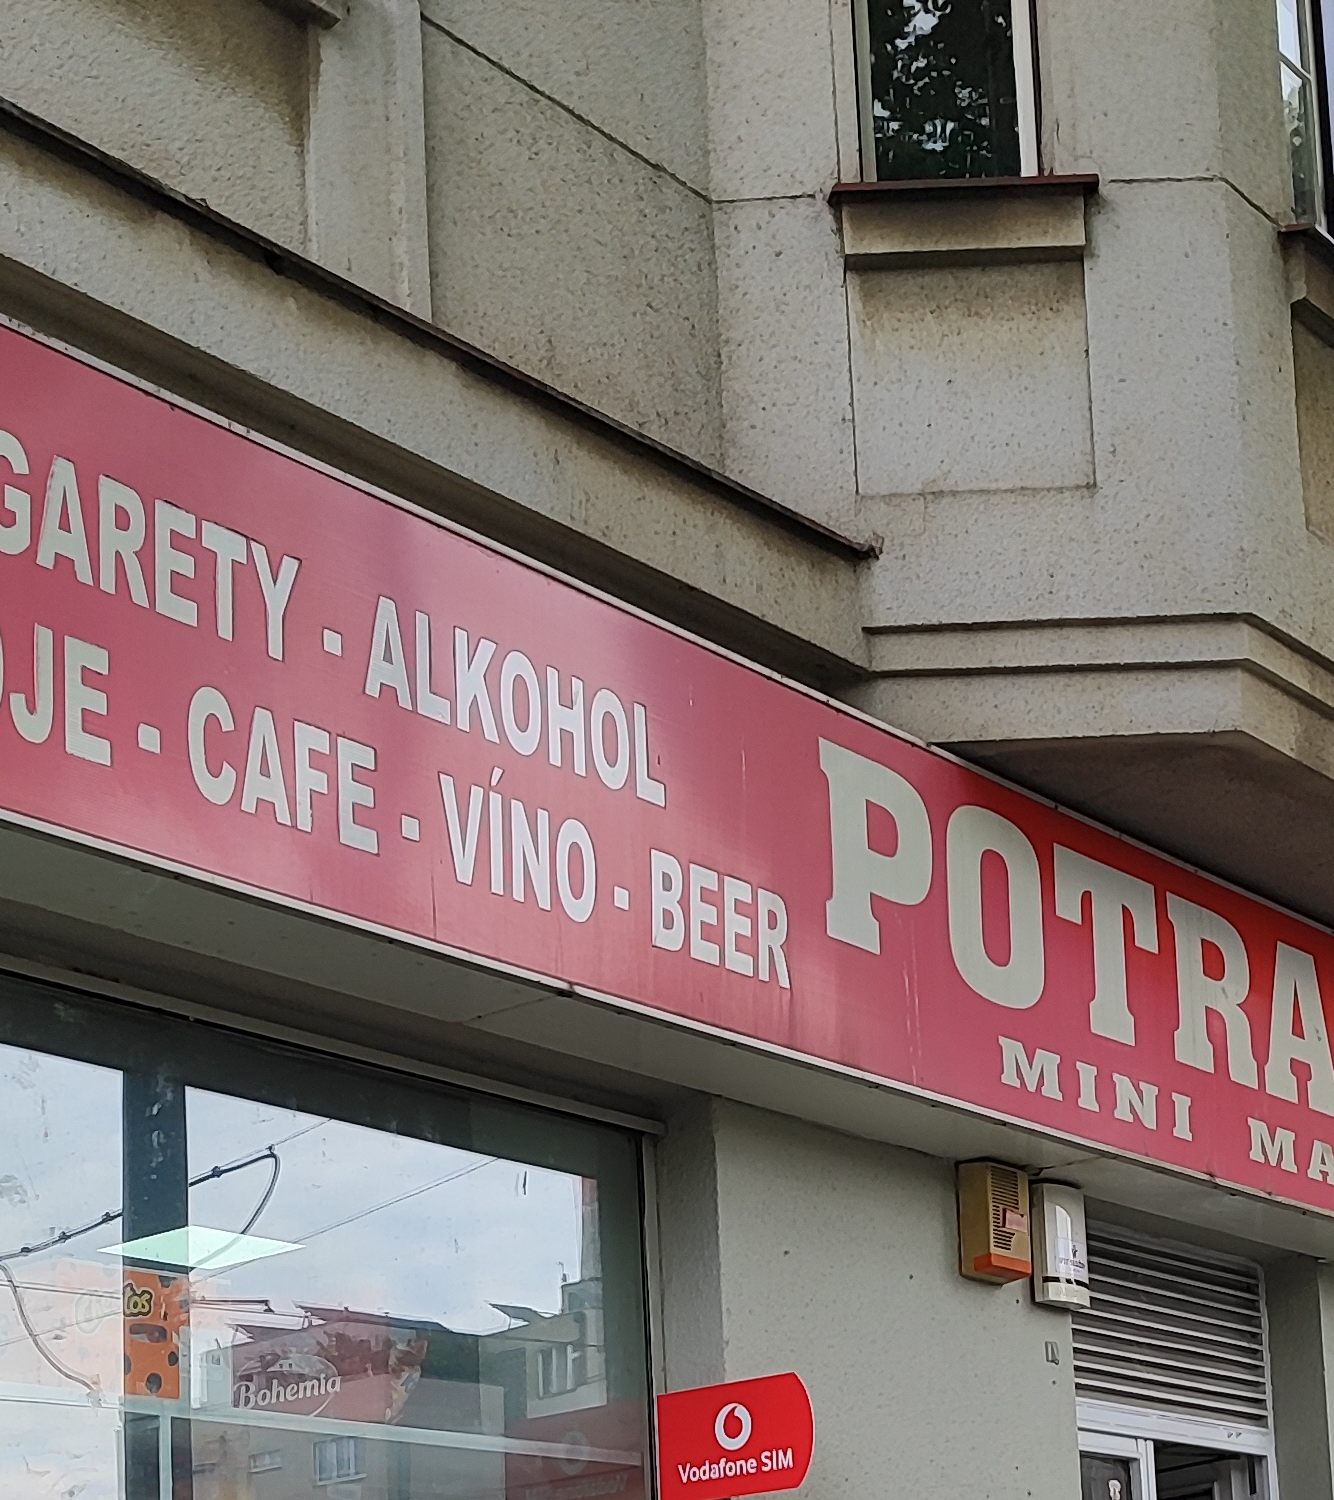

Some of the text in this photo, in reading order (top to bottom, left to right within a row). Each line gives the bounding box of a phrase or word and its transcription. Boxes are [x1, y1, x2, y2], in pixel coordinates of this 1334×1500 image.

[364, 595, 666, 808] ALKOHOL
[187, 686, 378, 854] CAFE
[438, 767, 596, 922] VÍNO
[649, 848, 791, 989] BEER
[998, 1035, 1193, 1142] MINI
[234, 1374, 341, 1409] Bohemia
[677, 1448, 794, 1484] Vodafone SIM
